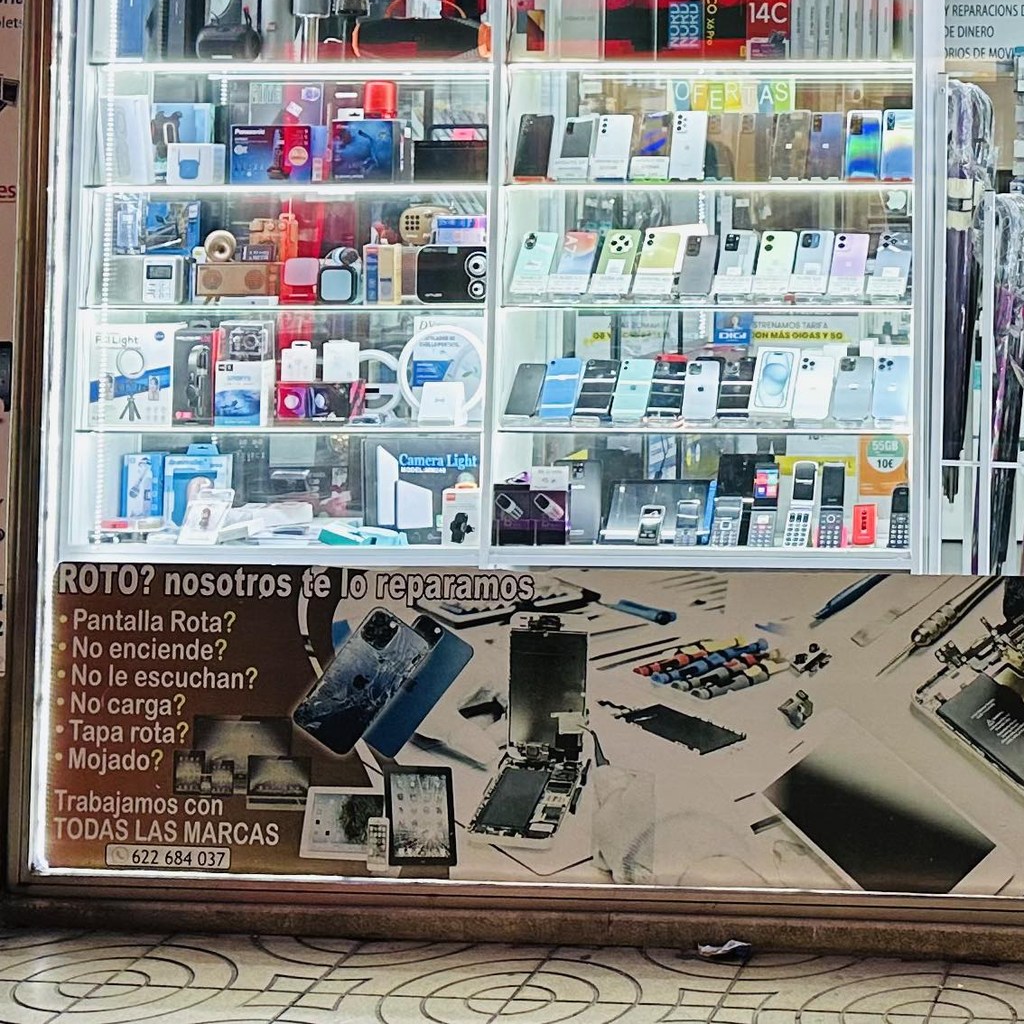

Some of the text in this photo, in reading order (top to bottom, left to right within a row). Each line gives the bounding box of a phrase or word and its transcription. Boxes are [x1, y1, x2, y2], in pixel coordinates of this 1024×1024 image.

[748, 2, 788, 24] 14C
[952, 4, 1018, 17] REPARACIONS
[957, 25, 995, 38] DINERO
[675, 80, 789, 110] OFERTAS
[399, 453, 478, 470] Camera Light
[877, 458, 893, 469] 10€
[58, 564, 535, 603] ROTO? nosotros te lo reparamos
[73, 609, 237, 635] Pantalla Rota?
[72, 637, 228, 661] No enciende?
[71, 664, 259, 690] No le escuchan?
[69, 692, 187, 720] No carga?
[68, 720, 190, 746] Tapa rota?
[68, 748, 164, 776] Mojado?
[54, 788, 224, 818] Trabajamos con
[53, 818, 280, 847] TODAS LAS MARCAS
[131, 848, 227, 869] 622 684 037
